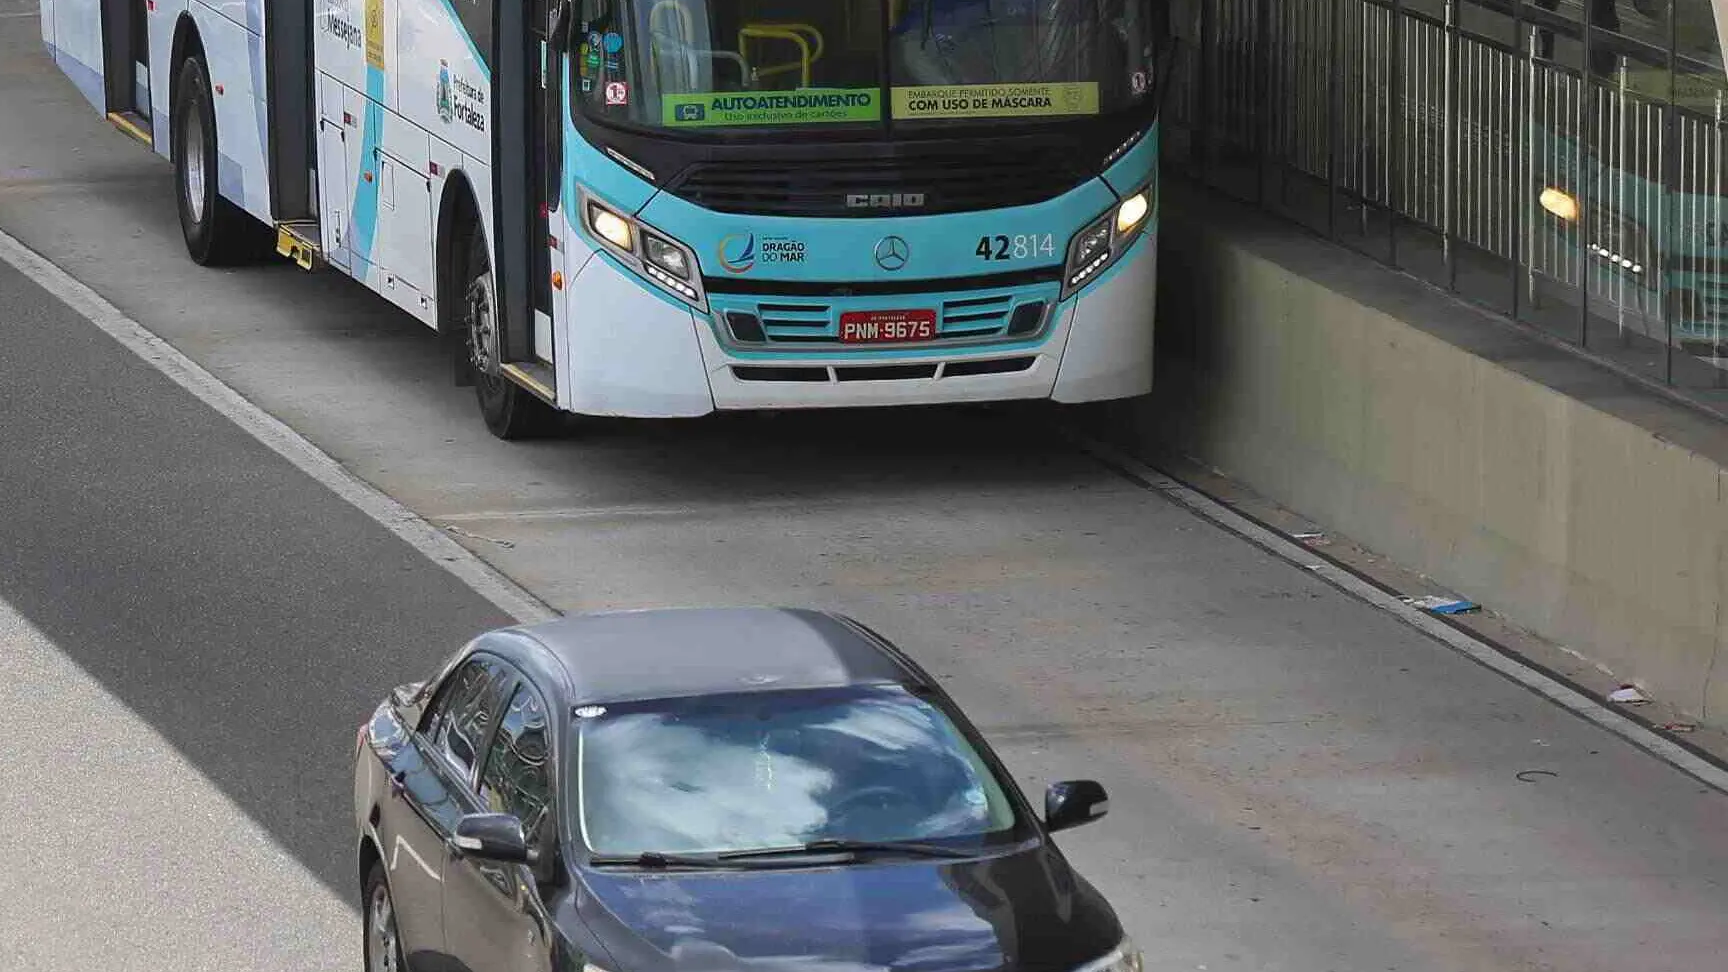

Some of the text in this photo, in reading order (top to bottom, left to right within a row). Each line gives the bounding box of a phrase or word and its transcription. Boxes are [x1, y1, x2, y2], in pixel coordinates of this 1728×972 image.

[711, 93, 872, 111] AUTOATENDIMENTO
[908, 99, 938, 111] COM
[942, 99, 969, 111] USO
[972, 98, 988, 109] DE
[453, 94, 485, 132] Fortaleza
[845, 193, 925, 209] CAIO
[762, 239, 806, 252] DRAGÃO
[762, 252, 805, 262] DO MAR
